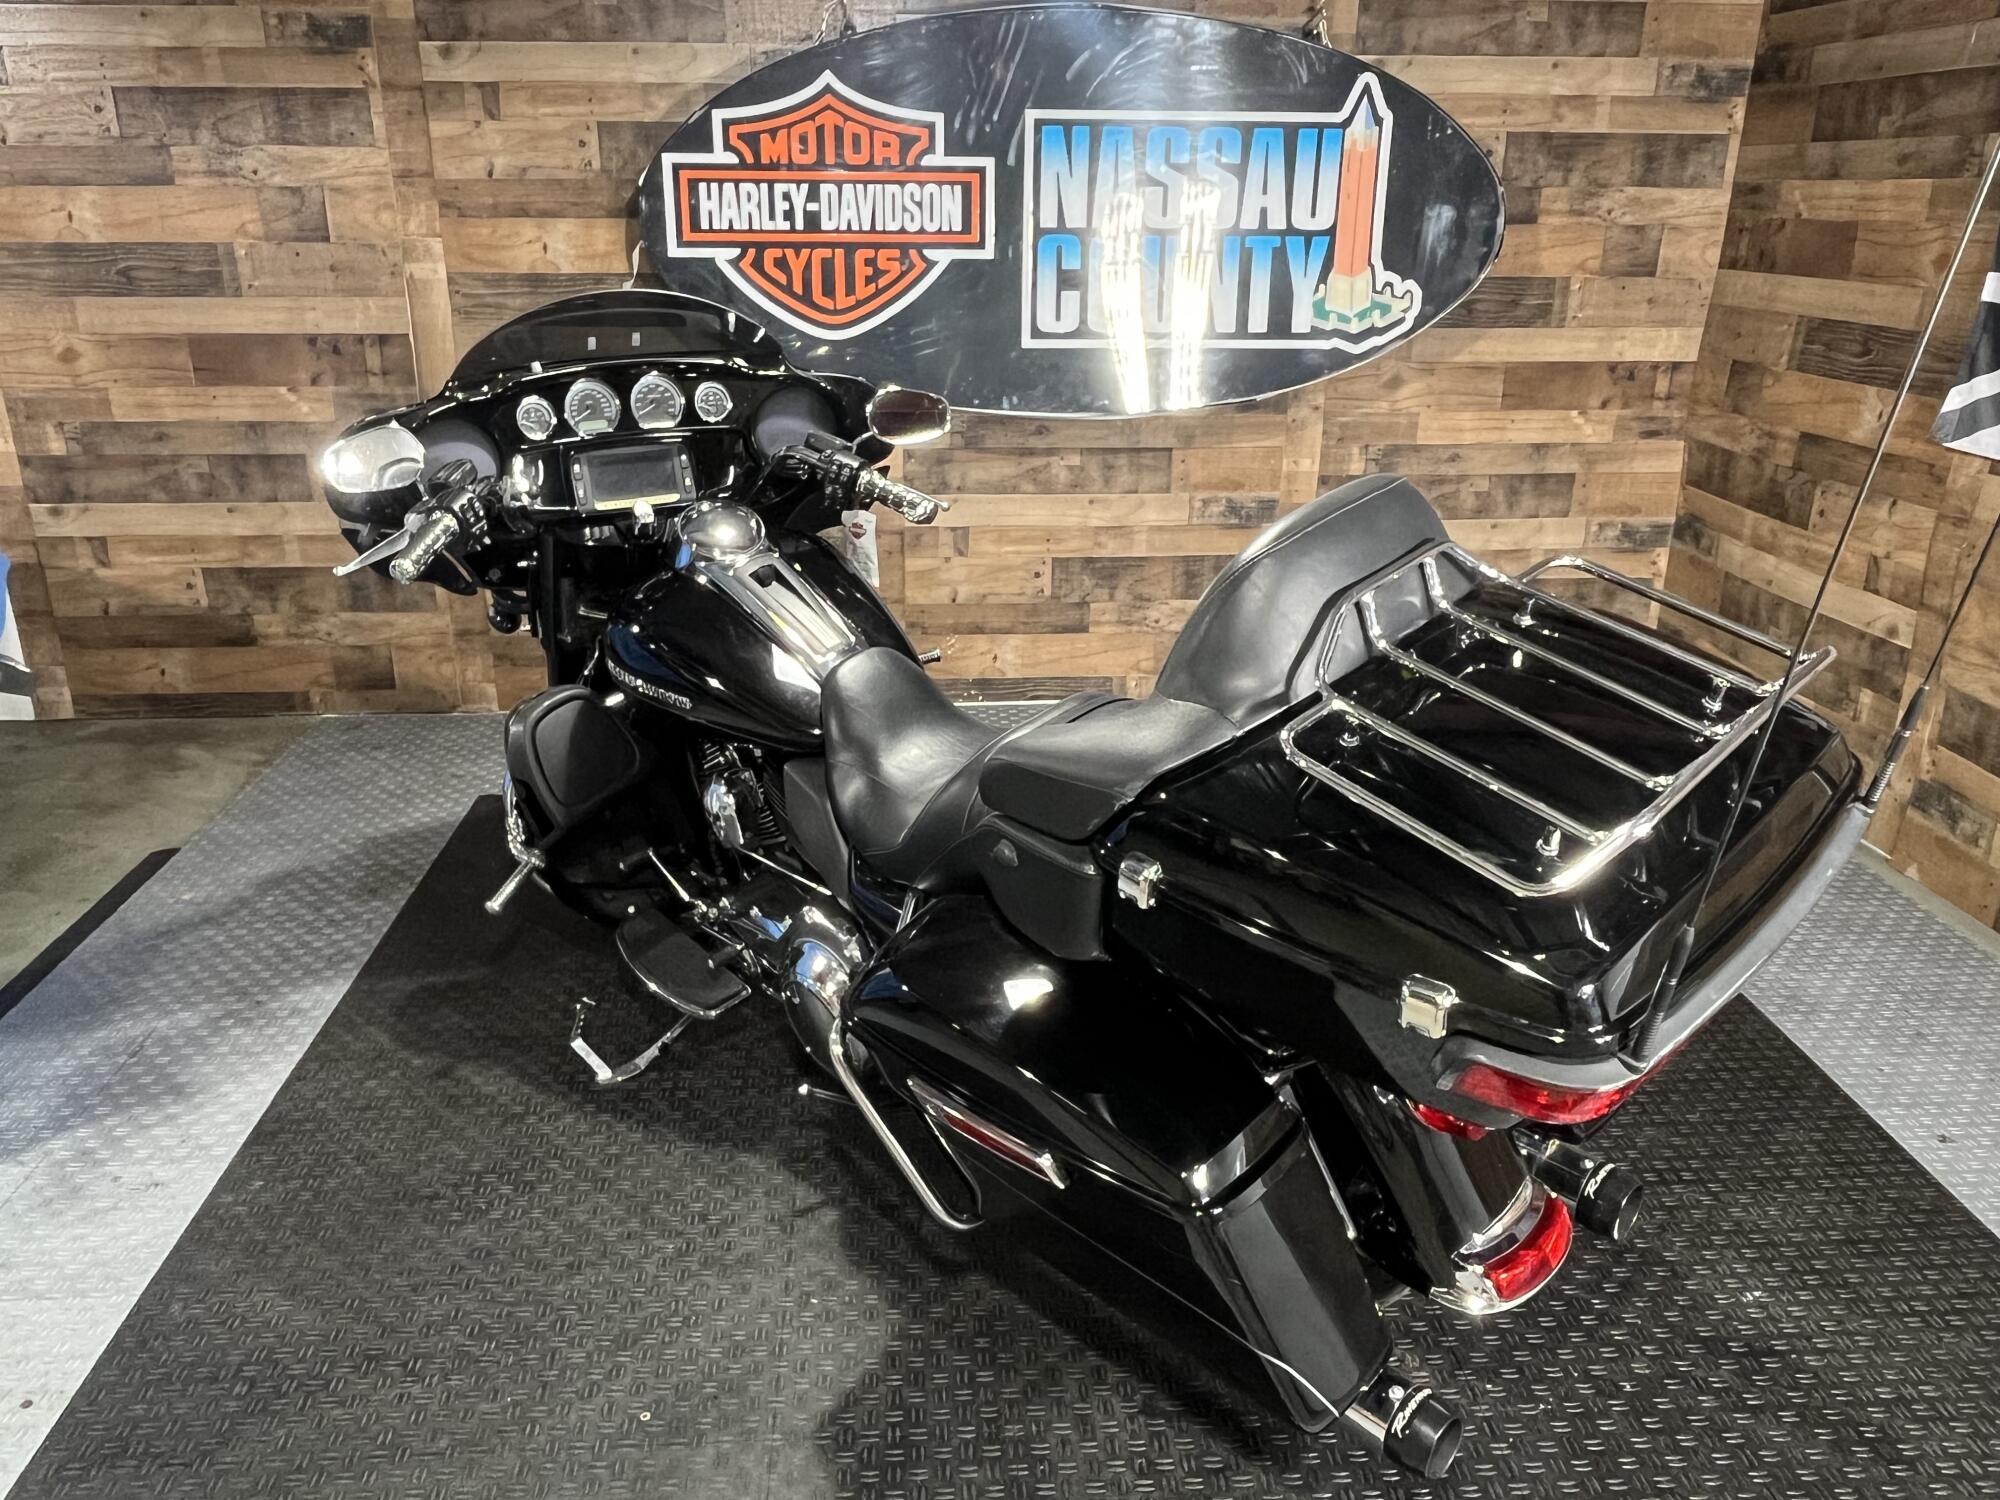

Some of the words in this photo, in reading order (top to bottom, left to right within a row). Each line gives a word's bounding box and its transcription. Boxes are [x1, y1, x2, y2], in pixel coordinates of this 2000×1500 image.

[760, 109, 900, 166] MOTOR
[698, 182, 962, 232] HARLEY-DAVIDSON
[1039, 125, 1343, 231] NASSAU
[763, 248, 903, 310] CYCLES
